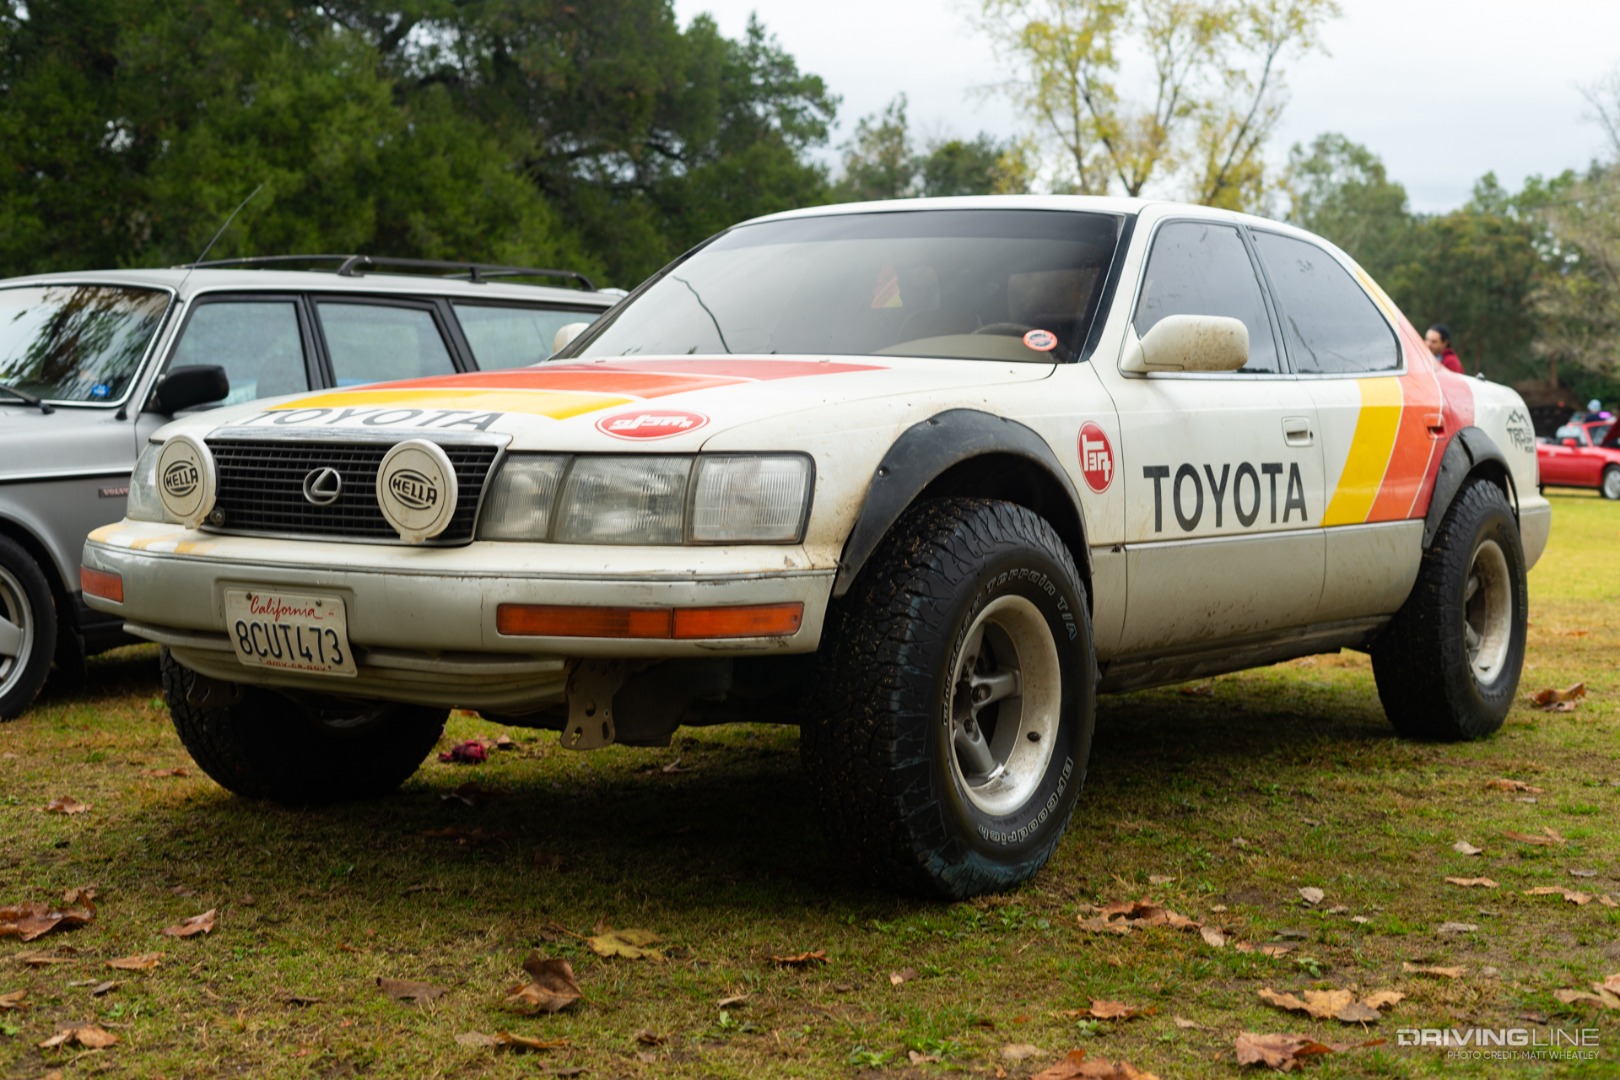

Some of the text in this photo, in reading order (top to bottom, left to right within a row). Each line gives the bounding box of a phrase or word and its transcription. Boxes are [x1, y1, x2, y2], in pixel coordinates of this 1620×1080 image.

[240, 408, 505, 432] TOYOTA
[165, 467, 199, 488] HELLA
[391, 479, 438, 506] HELLA
[1142, 461, 1308, 533] TOYOTA
[986, 567, 1056, 597] Terrain
[250, 595, 324, 622] California
[235, 620, 344, 665] 8CUT473
[978, 756, 1074, 846] BFGoodrich
